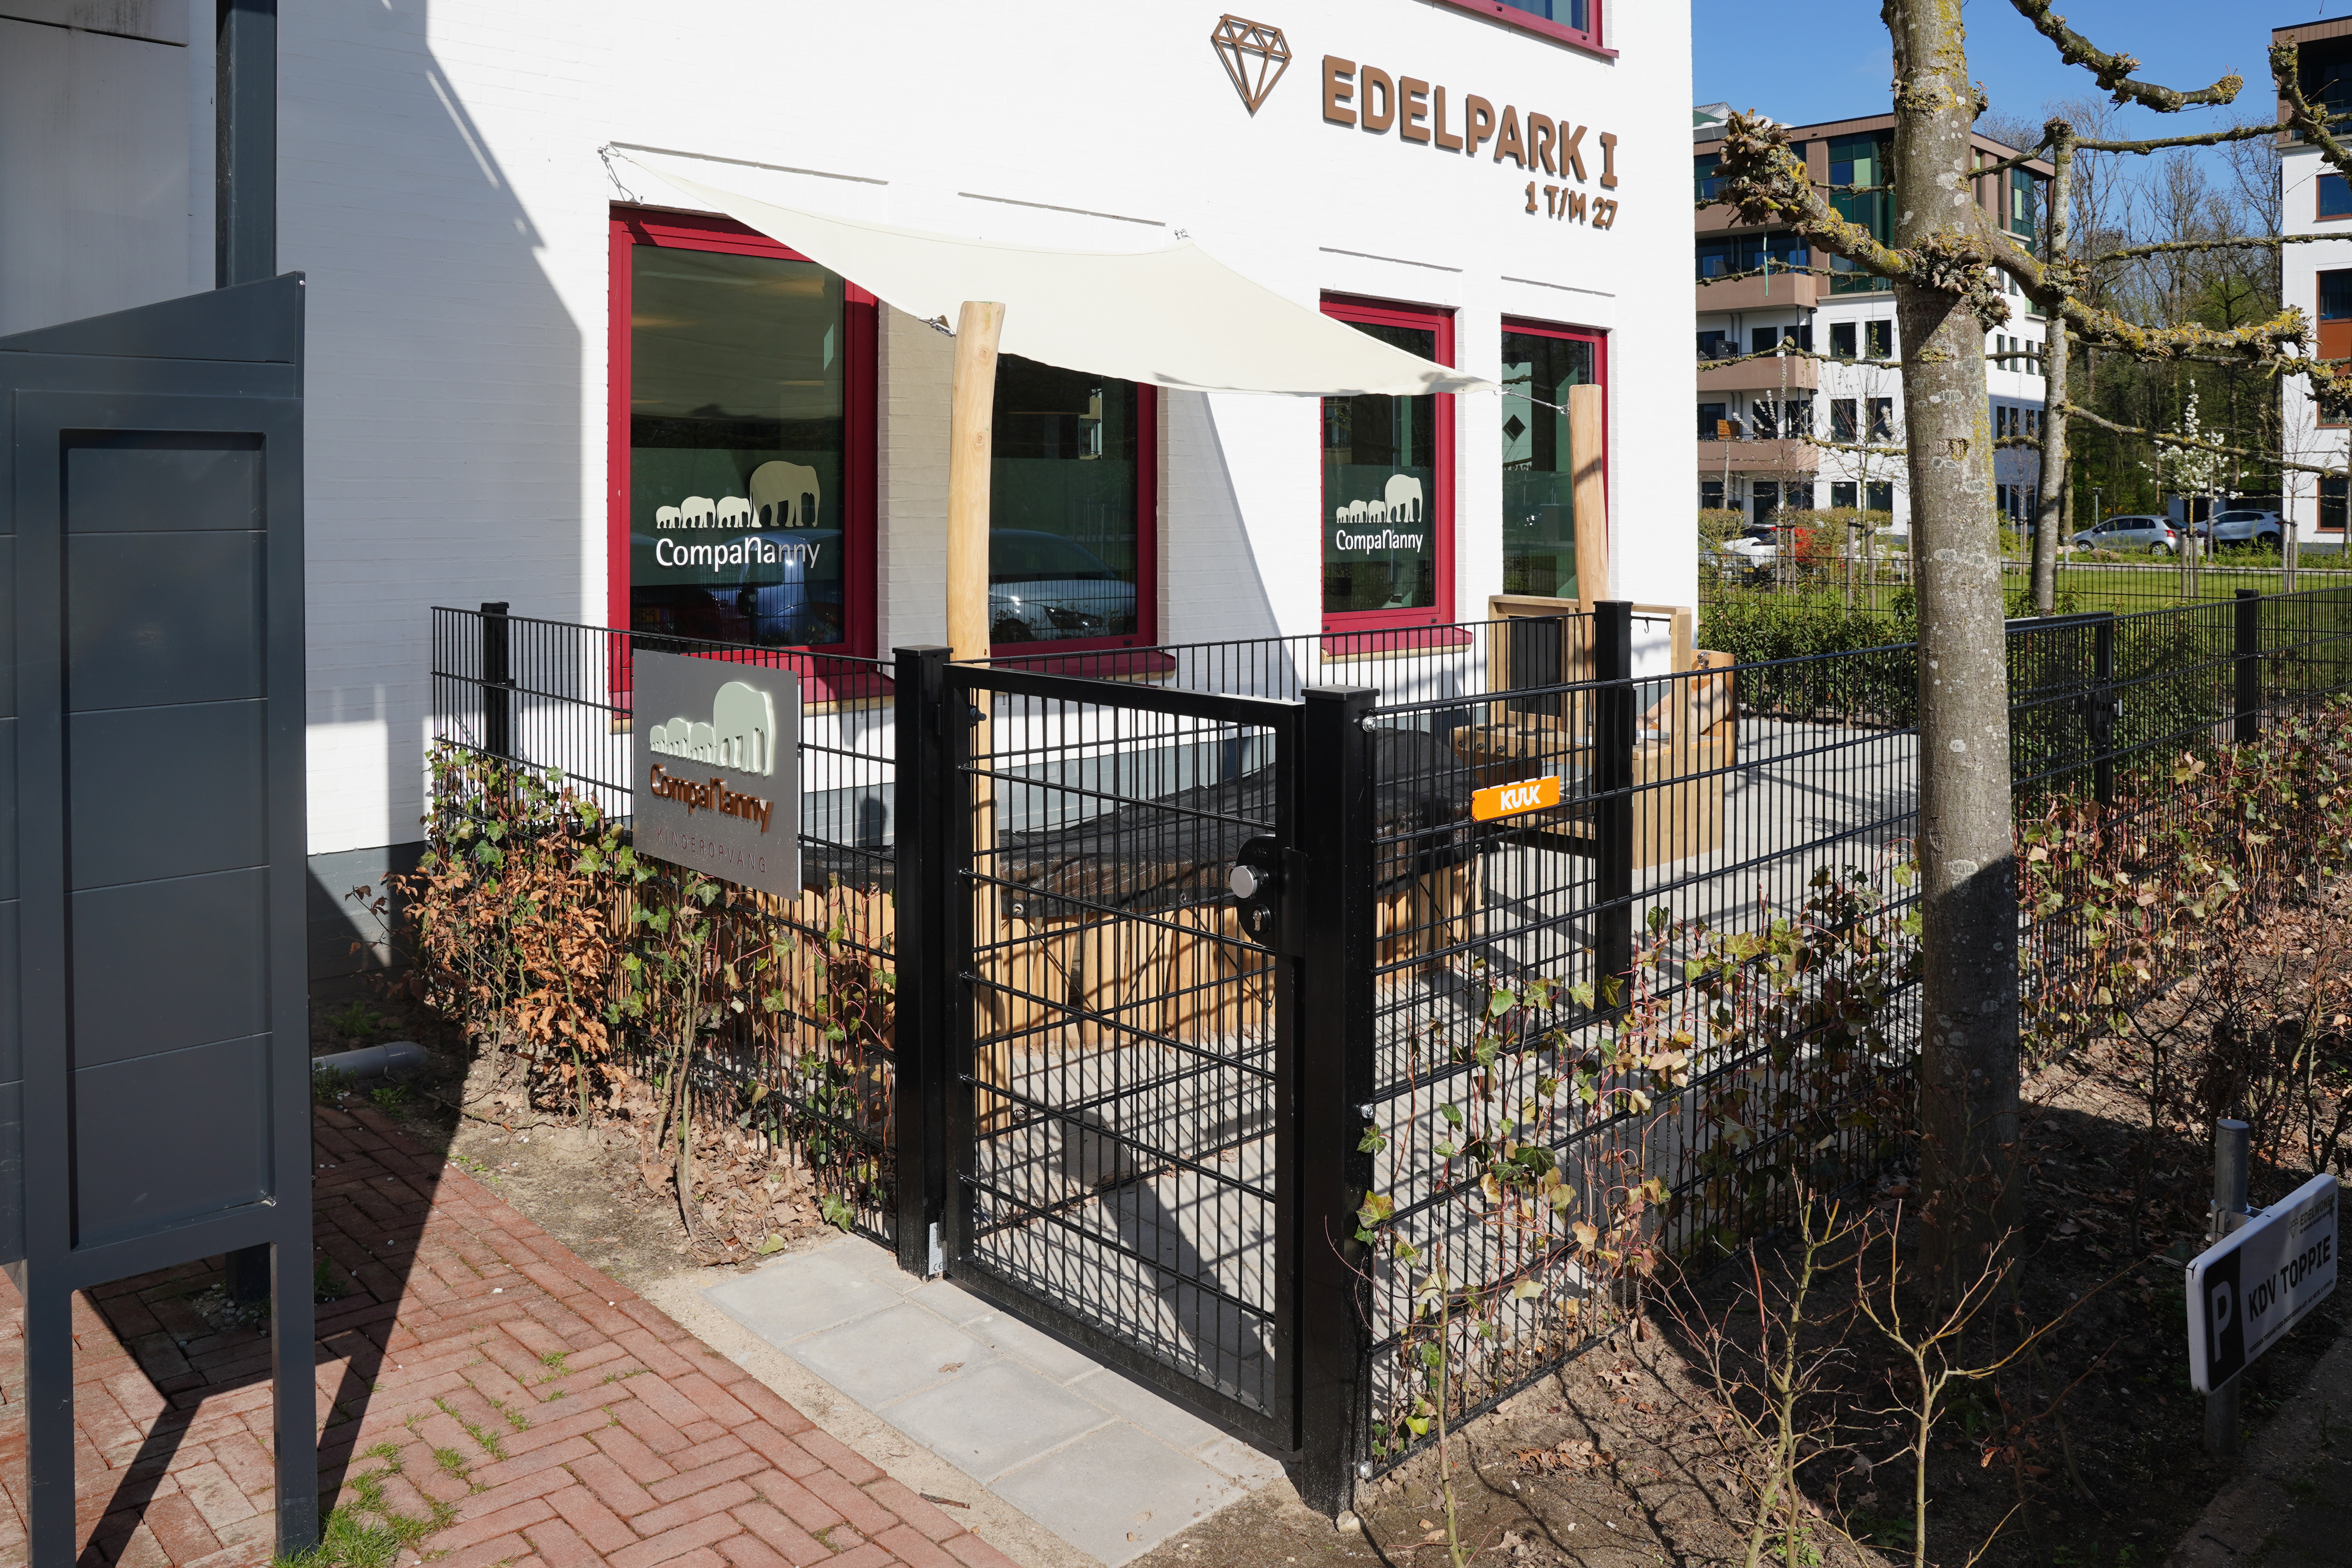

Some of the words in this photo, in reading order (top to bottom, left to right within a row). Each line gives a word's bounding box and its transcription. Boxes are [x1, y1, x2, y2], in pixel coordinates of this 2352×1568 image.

[1323, 54, 1587, 181] EDELPARK
[1526, 181, 1537, 213] 1
[1545, 184, 1586, 221] T/M
[1593, 196, 1617, 228] 27
[656, 537, 820, 572] CompaNanny
[1336, 529, 1423, 555] CompaNanny
[650, 763, 773, 833] CompaNanny
[1501, 785, 1541, 811] KUUK
[657, 828, 766, 873] KINDEROPVANG
[2300, 1192, 2335, 1226] EDELWONEN
[2248, 1273, 2276, 1322] KDV
[2280, 1235, 2331, 1294] TOPPIE
[2212, 1280, 2232, 1363] P
